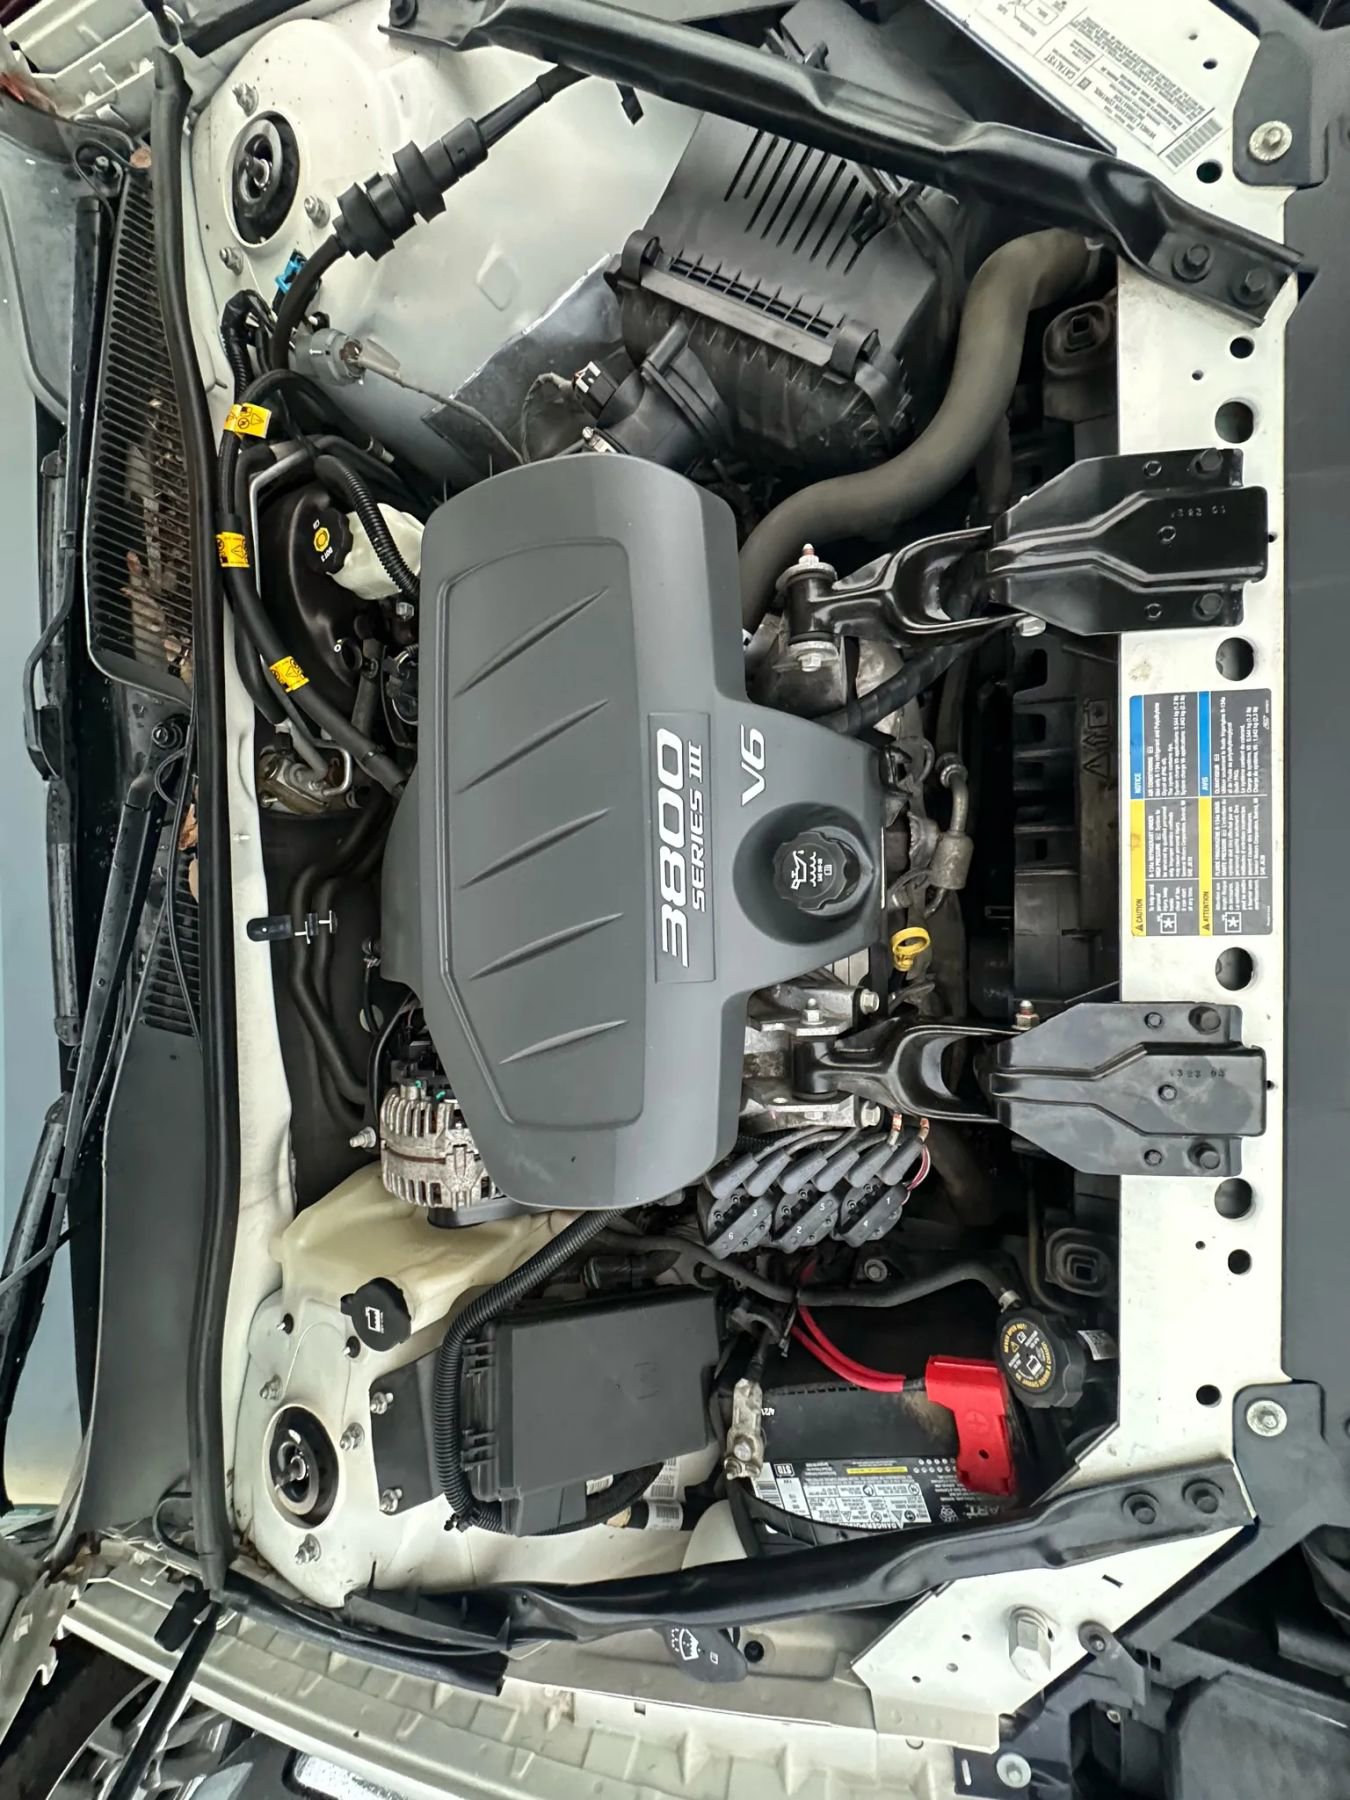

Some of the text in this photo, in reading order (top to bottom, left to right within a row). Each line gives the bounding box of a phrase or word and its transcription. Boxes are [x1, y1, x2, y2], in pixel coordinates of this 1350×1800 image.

[1043, 54, 1075, 79] CATALYST
[688, 740, 706, 913] SERIES III
[740, 724, 767, 806] V6
[656, 728, 689, 968] 3800
